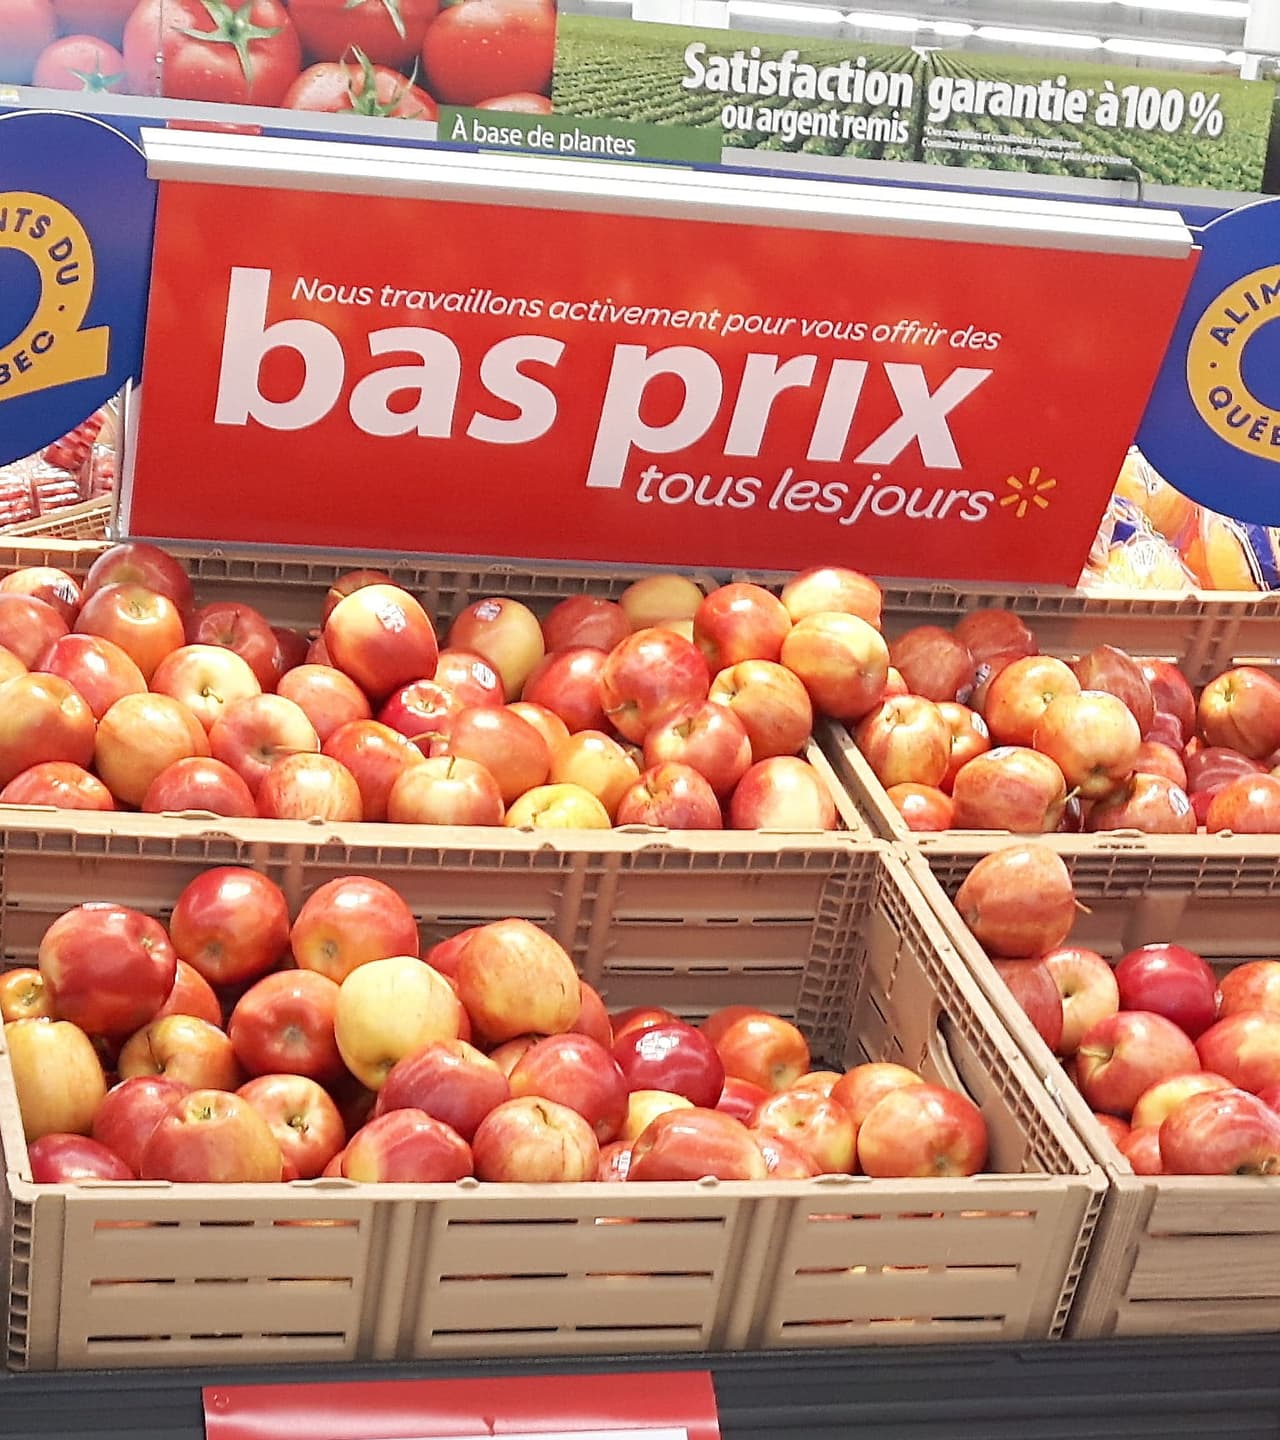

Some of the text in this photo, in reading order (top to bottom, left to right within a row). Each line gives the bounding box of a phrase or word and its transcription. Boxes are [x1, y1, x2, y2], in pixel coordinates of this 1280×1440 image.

[681, 41, 914, 108] Satisfaction
[1095, 79, 1120, 128] à
[1122, 84, 1185, 133] 100
[451, 112, 637, 156] À base de plantes
[721, 103, 754, 130] ou
[756, 106, 840, 143] argent
[842, 110, 909, 144] remis
[48, 237, 79, 286] DU
[291, 277, 1002, 352] Nous travaillons activement pour vous offrir des
[213, 266, 995, 490] bas prix
[635, 466, 995, 527] tous les jours
